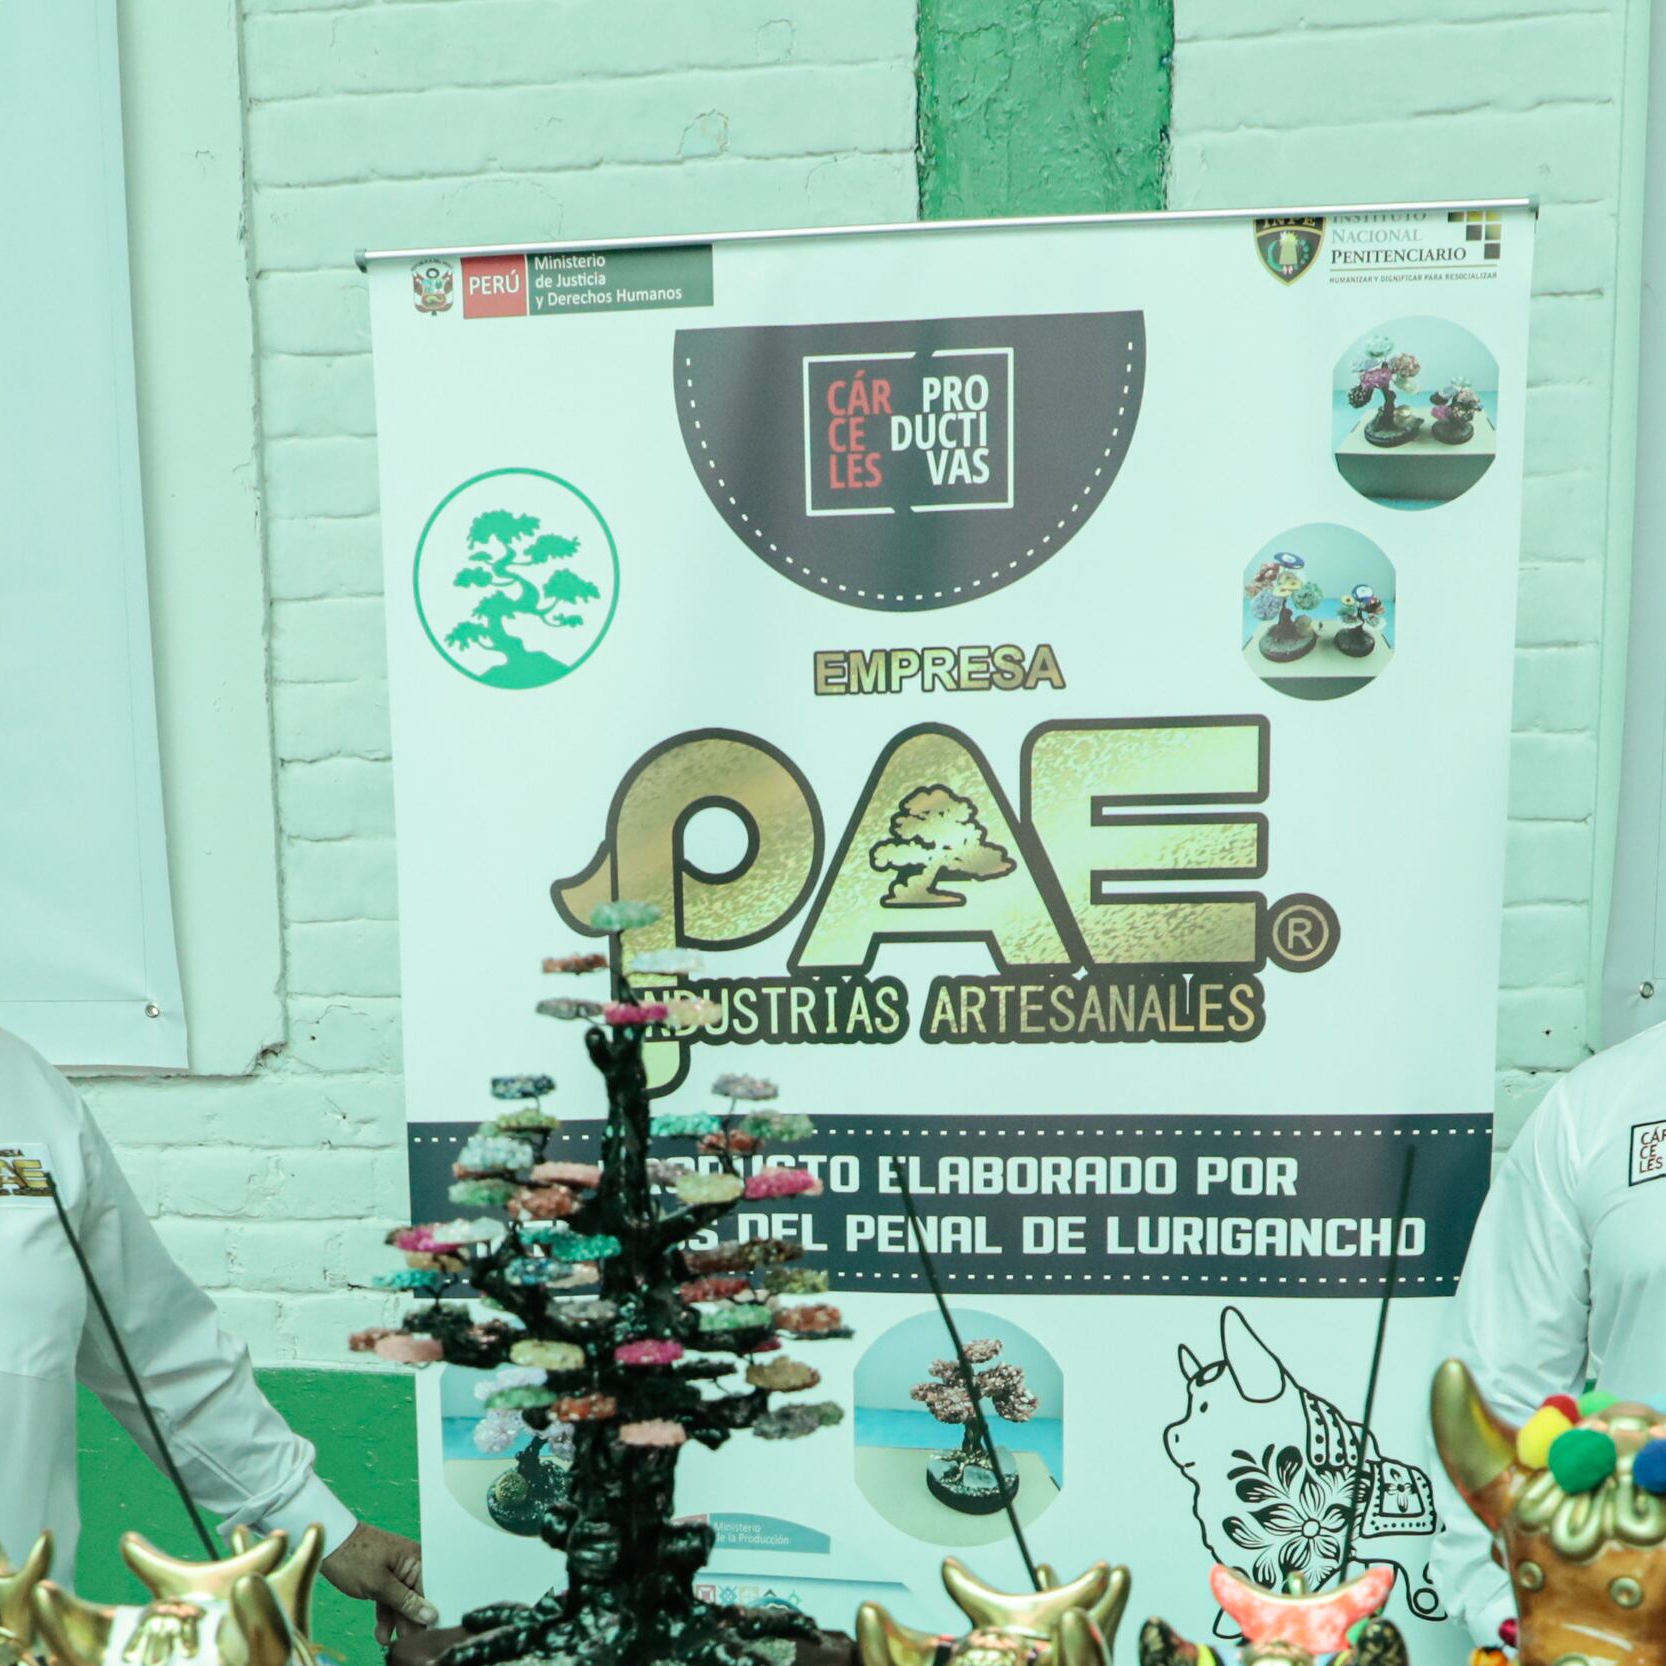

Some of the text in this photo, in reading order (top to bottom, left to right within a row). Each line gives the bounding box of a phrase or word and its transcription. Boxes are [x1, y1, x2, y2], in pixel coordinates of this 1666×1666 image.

[1332, 228, 1422, 243] NACIONAL
[534, 254, 606, 271] Ministerio
[1331, 247, 1467, 265] PENITENCIARIO
[468, 269, 520, 295] PERÚ
[535, 273, 606, 288] de Justicia
[1329, 276, 1373, 284] HUMANIZAR
[1380, 274, 1422, 283] DIGNIFICAR
[1424, 273, 1443, 282] PARA
[1445, 271, 1498, 281] RESOCIALIZAR
[535, 287, 683, 310] y Derechos Humanos
[827, 370, 989, 416] CÁR PRO
[828, 411, 987, 452] CE DUCTI
[829, 447, 990, 488] LES VAS
[813, 644, 1066, 696] EMPRESA
[551, 714, 1271, 1098] PAE
[930, 984, 1255, 1034] ARTESANALES
[1640, 1144, 1657, 1159] CE
[878, 1155, 1178, 1196] ELABORADO
[1196, 1156, 1299, 1196] POR
[1639, 1156, 1663, 1173] LES
[738, 1213, 828, 1250] DEL
[846, 1214, 1002, 1253] PENAL
[1022, 1215, 1087, 1254] DE
[1106, 1215, 1427, 1257] LURIGANCHO
[713, 1522, 761, 1534] Ministerio
[738, 1534, 790, 1546] Producción
